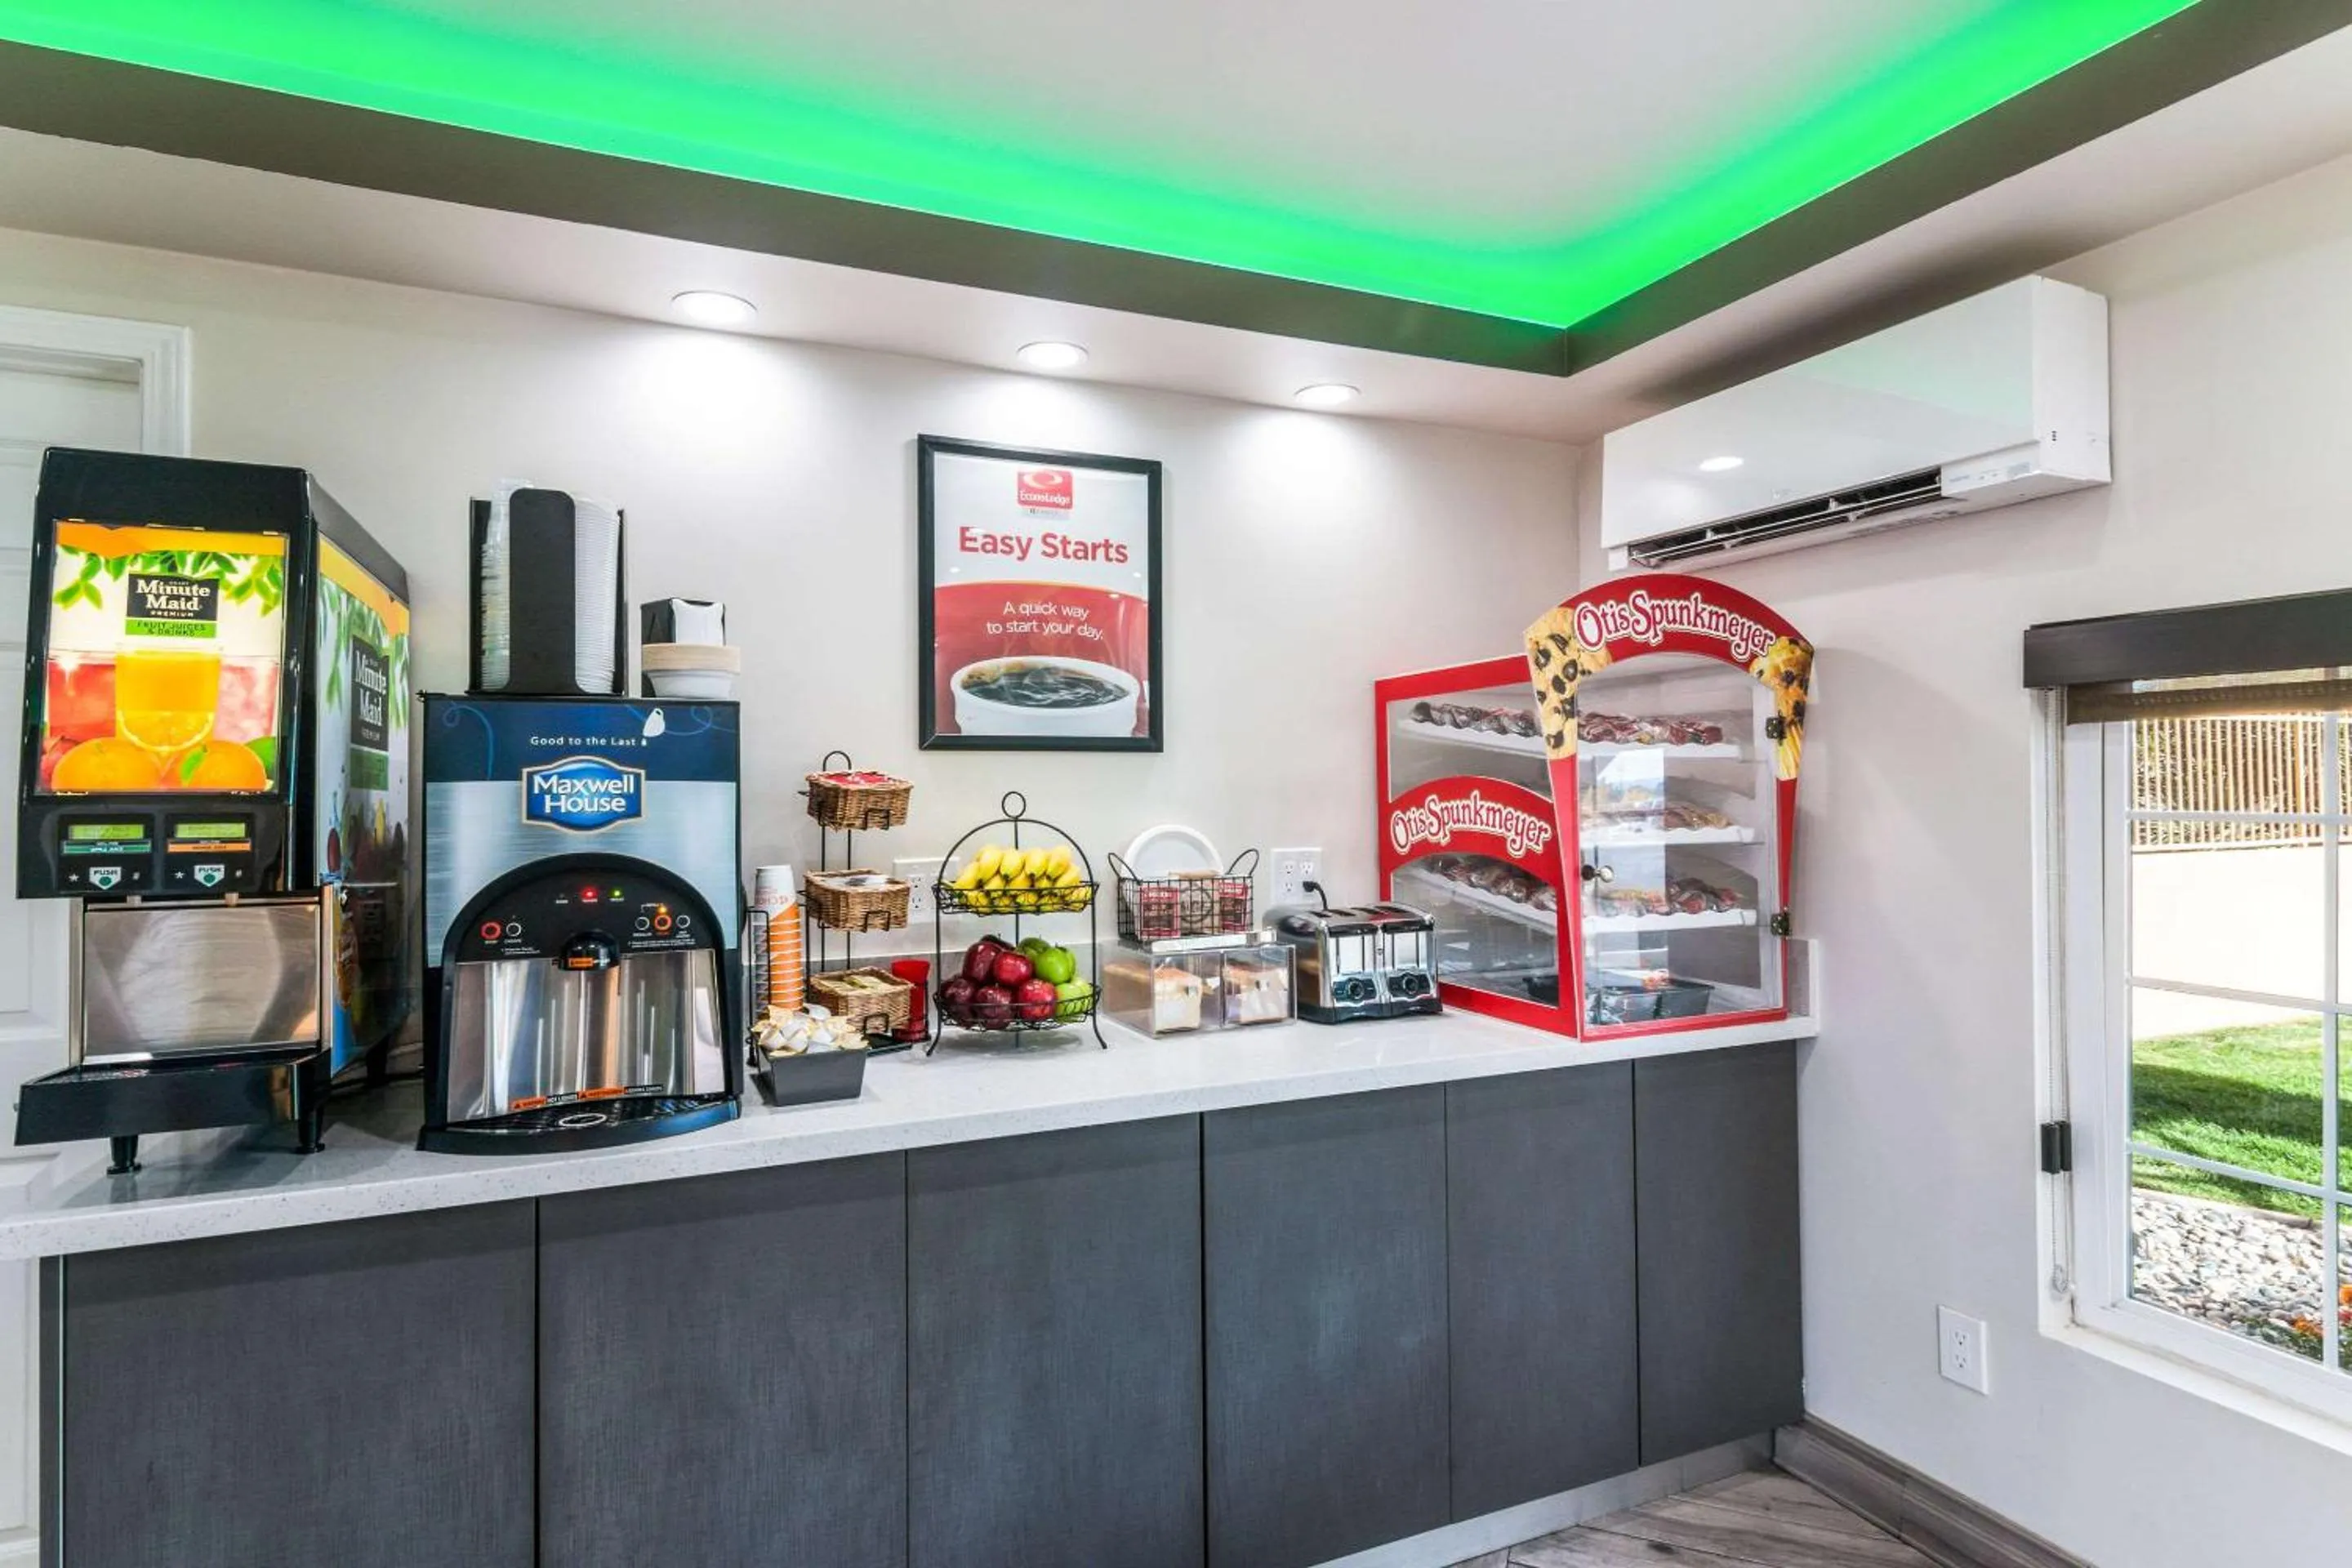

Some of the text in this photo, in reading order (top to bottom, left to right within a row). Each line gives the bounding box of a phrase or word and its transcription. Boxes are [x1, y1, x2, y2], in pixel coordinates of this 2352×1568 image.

[959, 525, 1129, 564] Easy Starts
[136, 579, 211, 597] Minute
[146, 594, 200, 612] Maid
[1003, 600, 1089, 621] A quick way
[168, 622, 207, 630] JUICES
[987, 621, 1003, 635] to
[1005, 620, 1039, 634] start
[1041, 621, 1075, 636] your
[1576, 593, 1775, 660] Otis Spunkmeyer
[355, 650, 387, 696] Minute
[359, 688, 383, 727] Maid
[531, 737, 635, 746] Good to the Last
[532, 774, 635, 795] Maxwell
[545, 794, 627, 813] House
[1392, 793, 1549, 852] Otis Spunkmeyer
